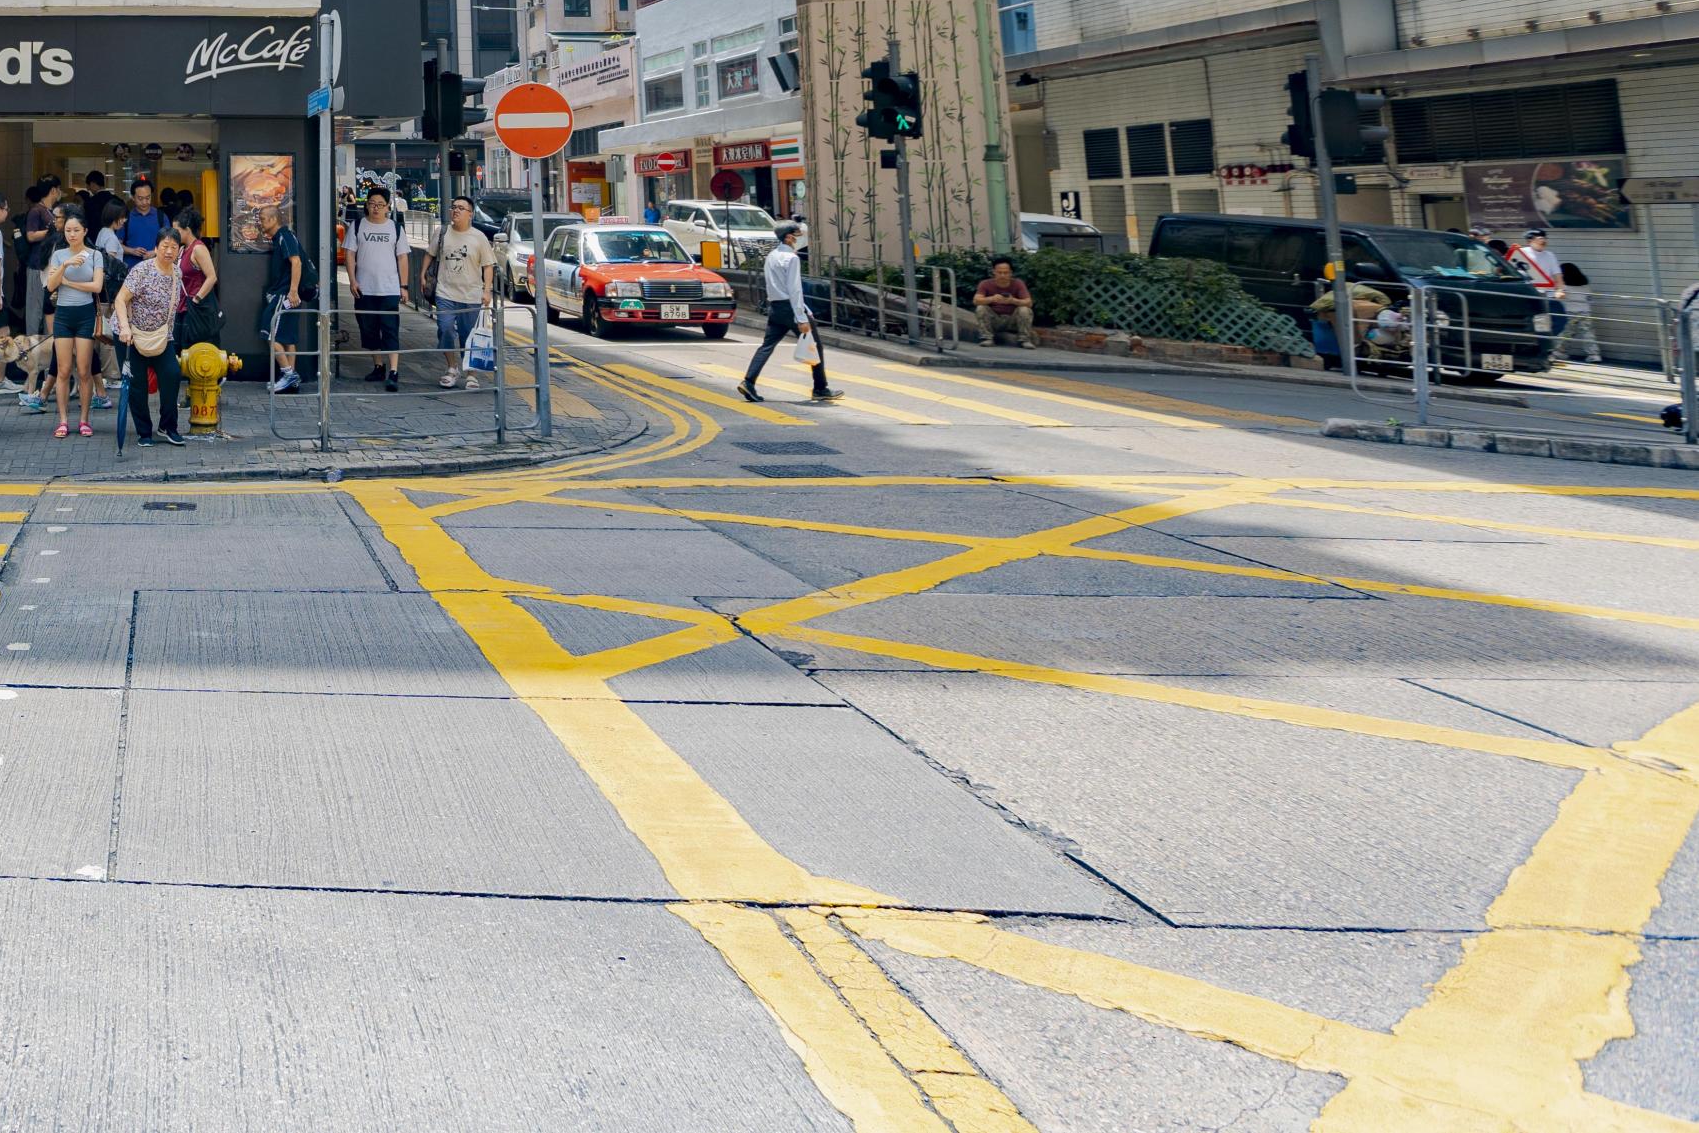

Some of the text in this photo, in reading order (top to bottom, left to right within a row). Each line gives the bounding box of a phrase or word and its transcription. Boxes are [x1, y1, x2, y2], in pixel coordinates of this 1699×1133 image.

[184, 25, 311, 85] McCafé
[363, 232, 391, 243] VANS
[663, 311, 687, 319] 8798
